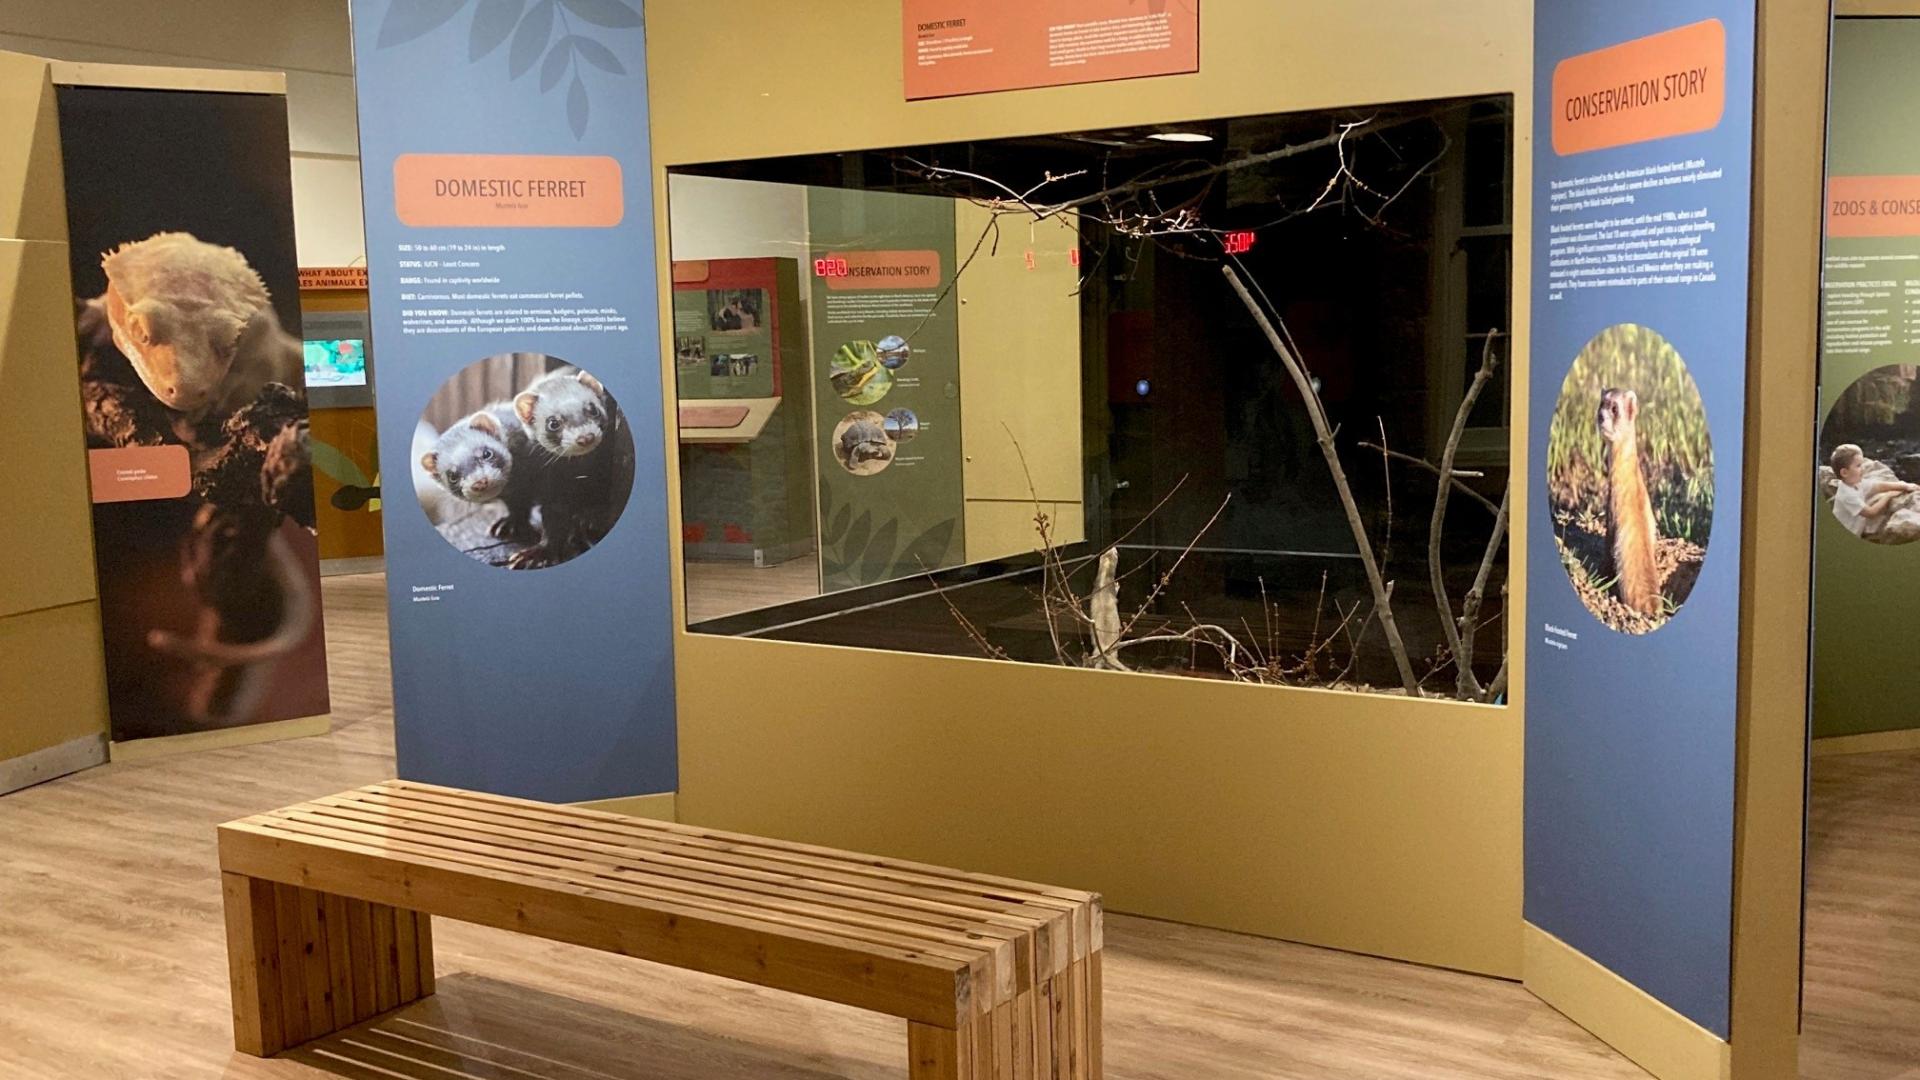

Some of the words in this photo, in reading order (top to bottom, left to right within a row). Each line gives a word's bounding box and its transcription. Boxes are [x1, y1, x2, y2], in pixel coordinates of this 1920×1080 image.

[918, 21, 945, 32] DOMESTIC
[946, 18, 966, 28] FERRET
[1566, 78, 1660, 122] CONSERVATION
[1664, 67, 1707, 102] STORY
[435, 179, 522, 198] DOMESTIC
[529, 180, 586, 198] FERRET
[1832, 200, 1865, 217] ZOOS
[1869, 200, 1878, 215] &
[838, 267, 902, 277] NSERVATION
[905, 266, 930, 276] STORY
